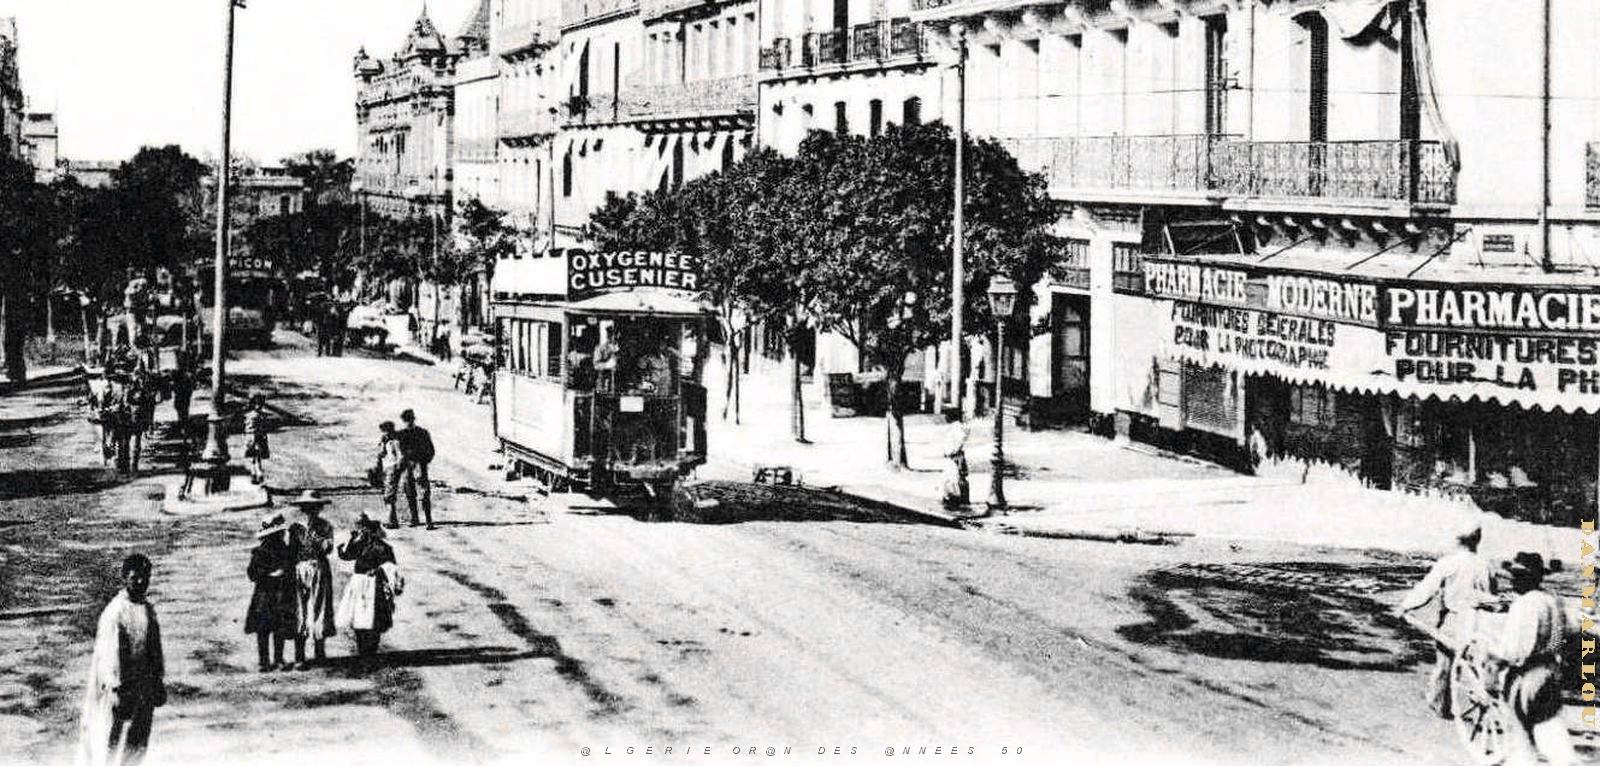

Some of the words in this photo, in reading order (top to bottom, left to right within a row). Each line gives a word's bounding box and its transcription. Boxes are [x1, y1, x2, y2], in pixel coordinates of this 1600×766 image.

[571, 268, 697, 290] CUSENIER
[1143, 263, 1248, 302] PHARMACIE
[1265, 275, 1377, 321] MODERNE
[1387, 287, 1600, 331] PHARMACIE
[1385, 331, 1598, 365] FOURNITURES
[1395, 359, 1477, 385] POUR
[1496, 364, 1537, 391] LA
